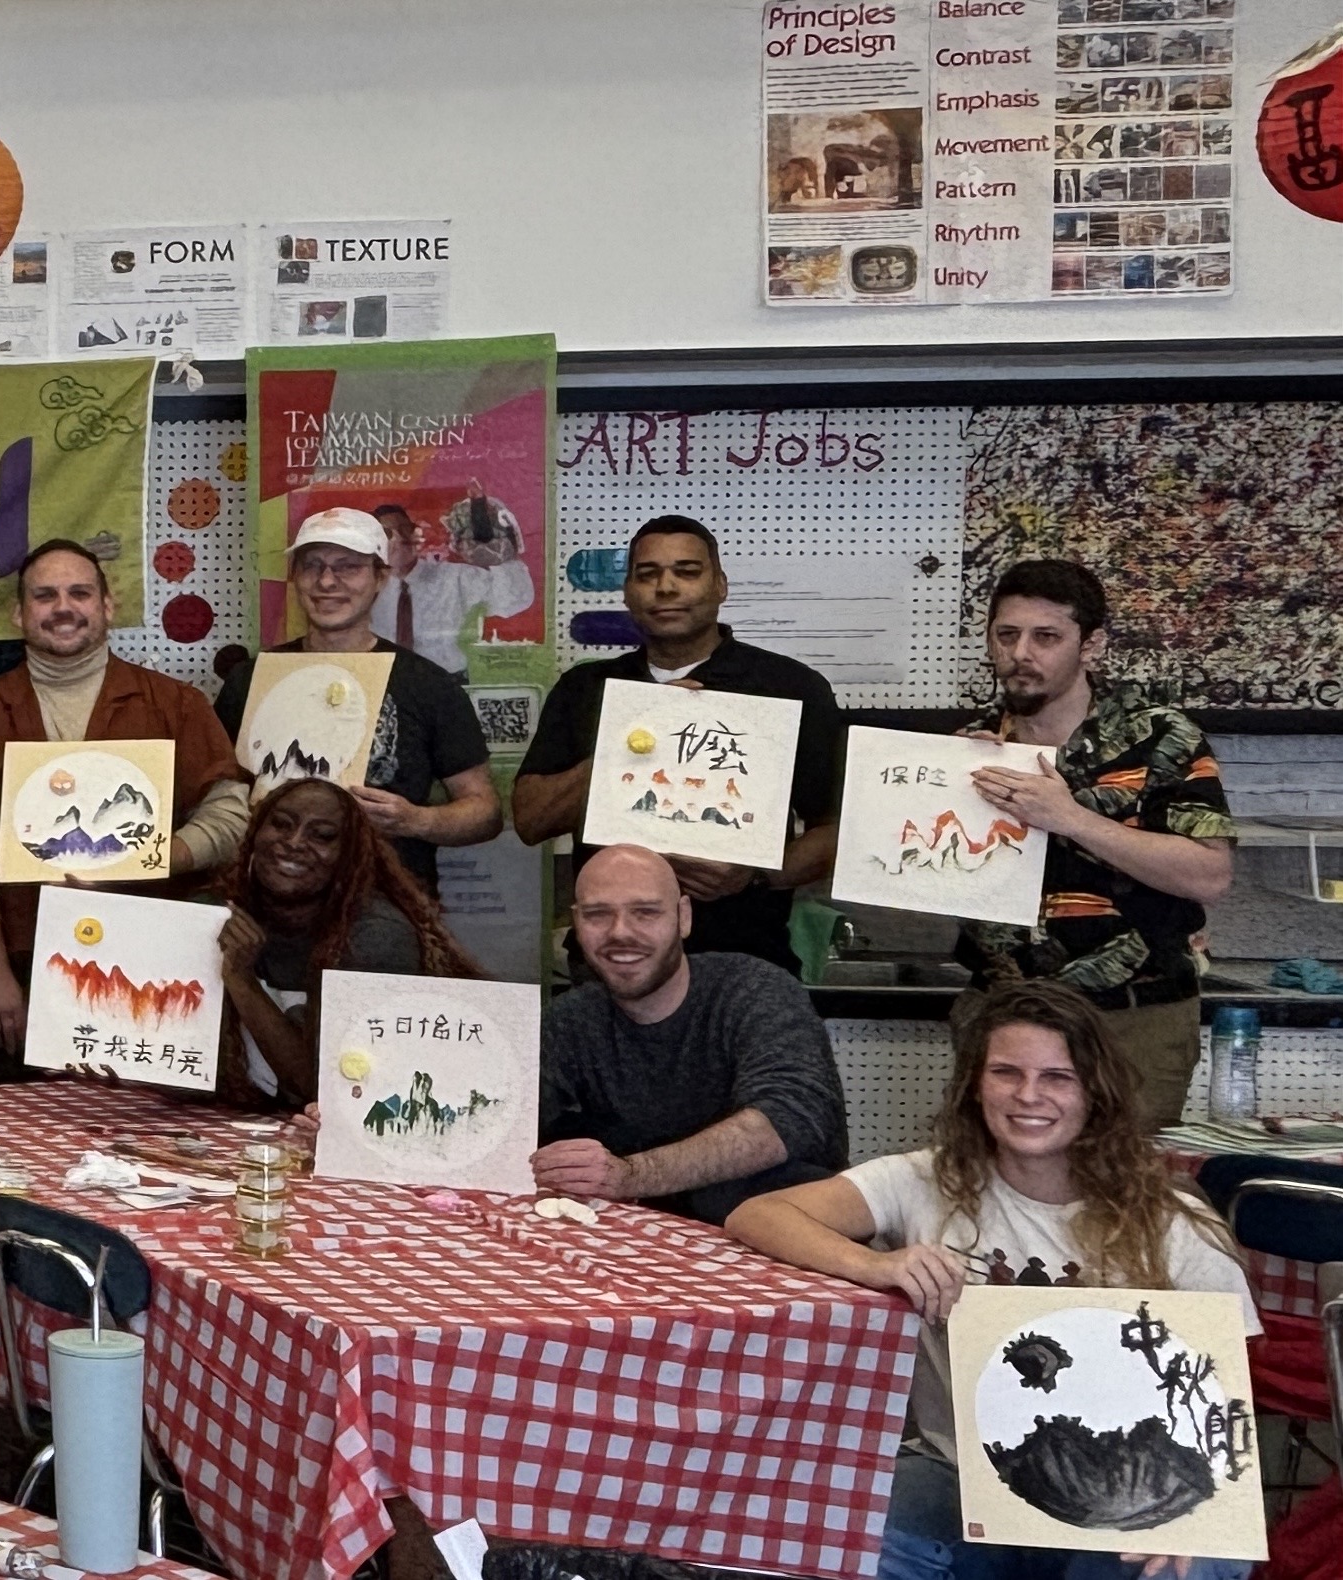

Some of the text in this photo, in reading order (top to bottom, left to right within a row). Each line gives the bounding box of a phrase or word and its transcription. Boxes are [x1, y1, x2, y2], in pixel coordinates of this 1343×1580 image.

[768, 4, 897, 31] Principles
[937, 1, 1025, 19] Balance
[766, 29, 896, 58] of Design
[935, 46, 1032, 68] Contrast
[935, 89, 1041, 115] Emphasis
[934, 134, 1051, 156] Movement
[934, 180, 1017, 200] Pattern
[934, 222, 1020, 246] Rhythm
[149, 239, 235, 264] FORM
[325, 237, 450, 263] TEXTURE
[934, 267, 989, 289] Unity
[283, 410, 393, 434] TAIWAN
[556, 410, 885, 476] ART Jobs
[286, 448, 410, 468] LEARNING
